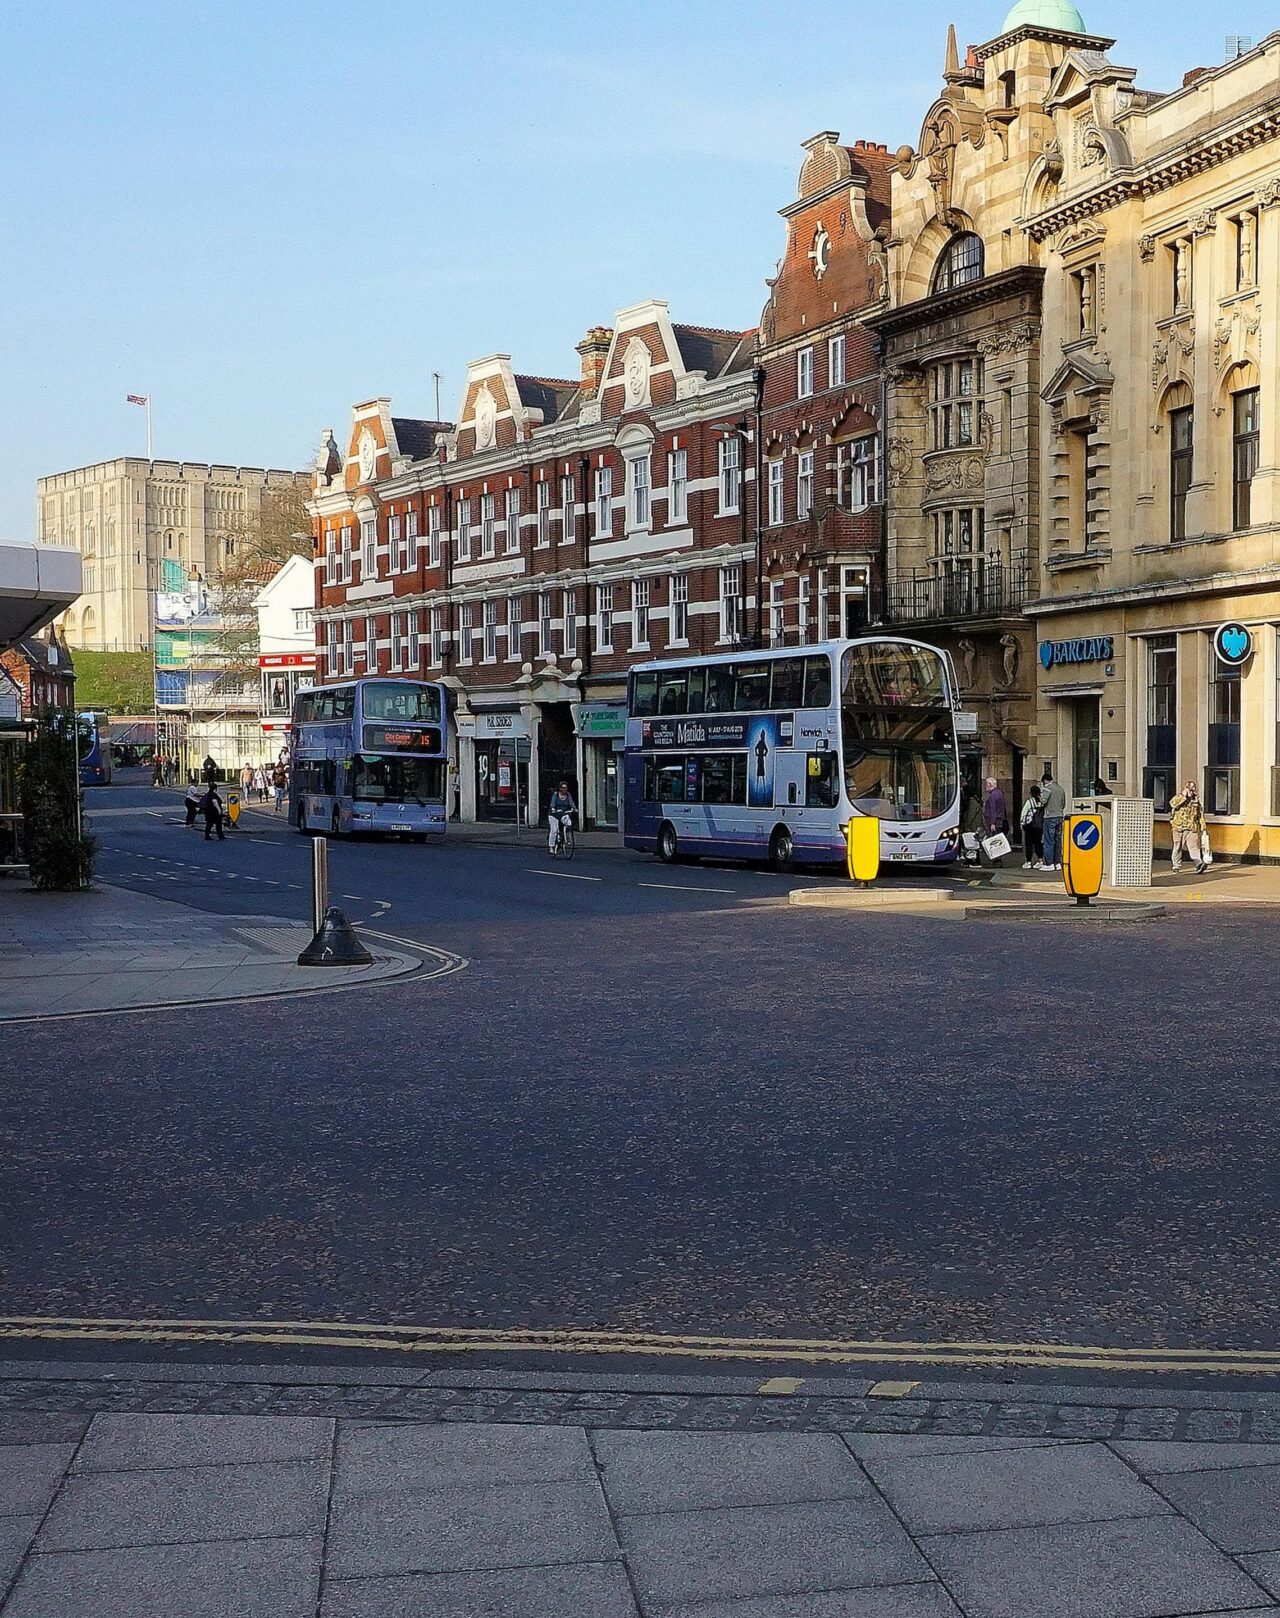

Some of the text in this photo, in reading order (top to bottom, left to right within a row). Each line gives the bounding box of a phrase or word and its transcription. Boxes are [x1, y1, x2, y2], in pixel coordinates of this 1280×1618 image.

[1053, 637, 1113, 663] BARCLAYS
[421, 735, 430, 745] 15
[677, 723, 706, 744] Matilda
[800, 728, 823, 738] Norwich
[479, 755, 488, 780] 19
